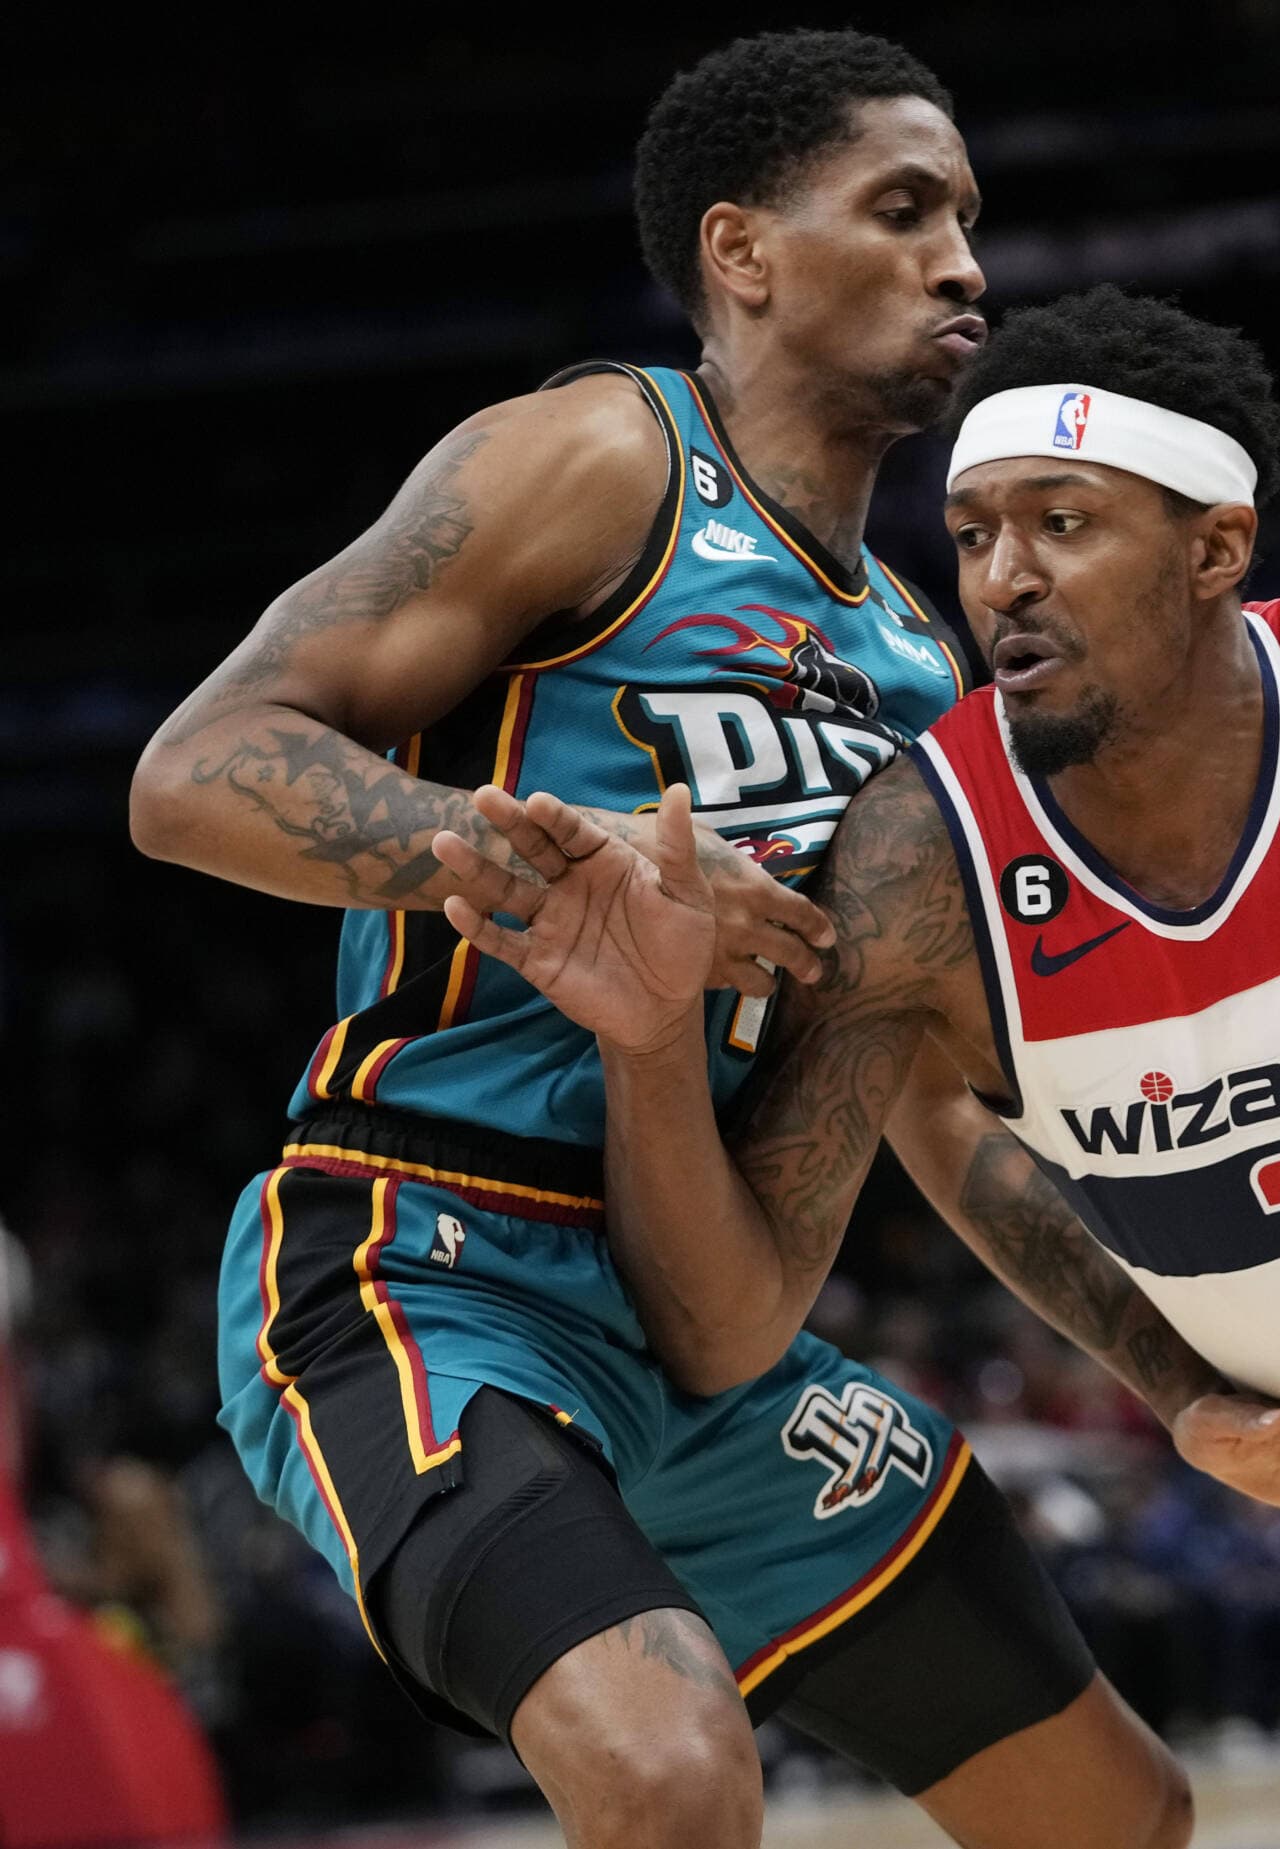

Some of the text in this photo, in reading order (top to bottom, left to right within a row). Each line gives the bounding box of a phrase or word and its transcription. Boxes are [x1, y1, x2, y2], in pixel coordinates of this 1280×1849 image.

[692, 455, 718, 501] 6
[704, 518, 758, 554] NIKE
[1015, 865, 1052, 917] 6
[430, 1249, 452, 1264] NBA
